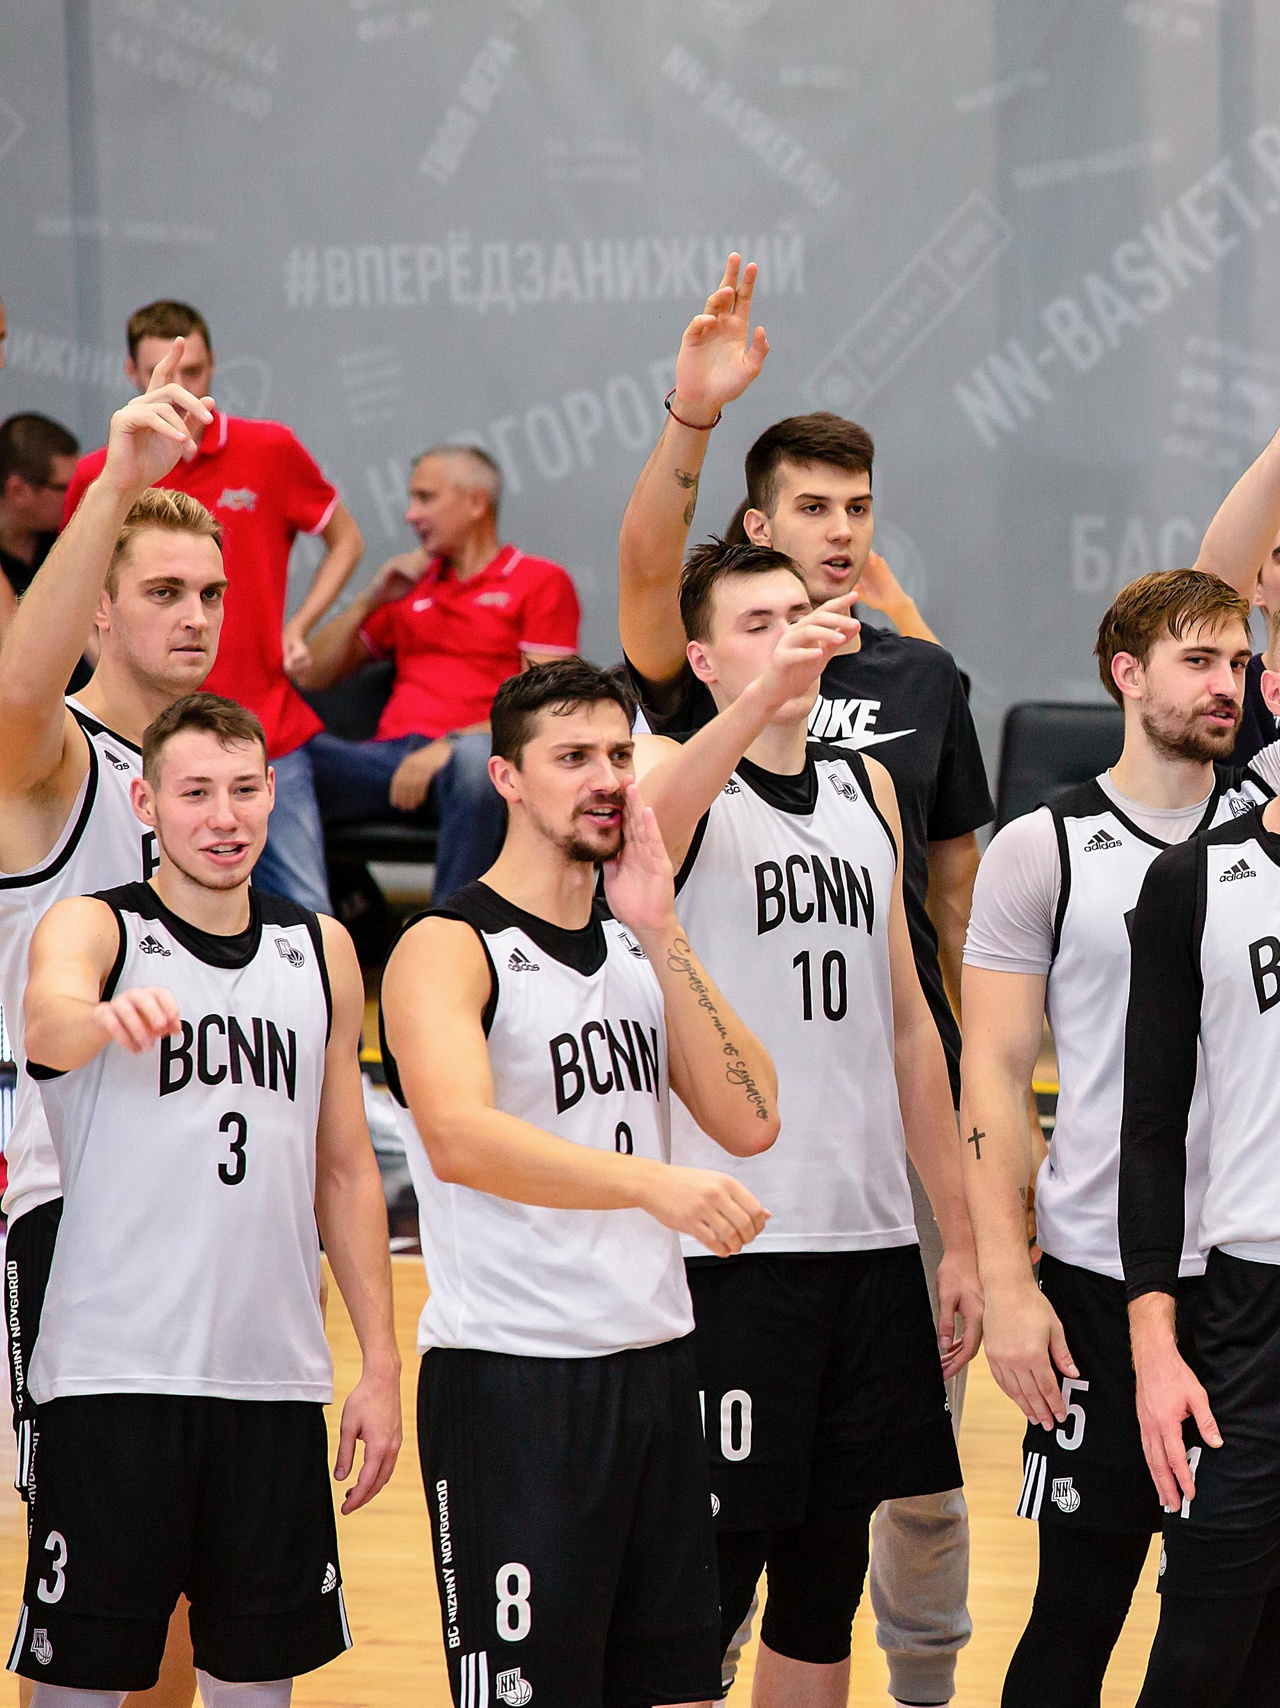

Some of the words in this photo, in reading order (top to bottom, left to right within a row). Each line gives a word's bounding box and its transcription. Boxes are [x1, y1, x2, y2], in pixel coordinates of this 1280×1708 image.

[284, 222, 805, 314] #ВПЕРЁДЗАНИЖНИЙ
[808, 694, 881, 738] NIKE
[1083, 838, 1122, 852] adidas
[1219, 868, 1257, 883] adidas
[754, 854, 876, 937] BCNN
[507, 958, 540, 972] adidas
[793, 949, 848, 1022] 10
[159, 1013, 297, 1103] BCNN
[549, 1018, 660, 1115] BCNN
[218, 1111, 248, 1186] 3
[7, 1260, 21, 1338] NOVGOROD
[11, 1341, 24, 1395] NIZHNY
[1056, 1377, 1089, 1451] 5
[436, 1479, 452, 1565] NOVGOROD
[37, 1531, 68, 1604] 3
[442, 1568, 459, 1624] NIZHNY
[495, 1562, 532, 1643] 8
[447, 1626, 461, 1648] BC
